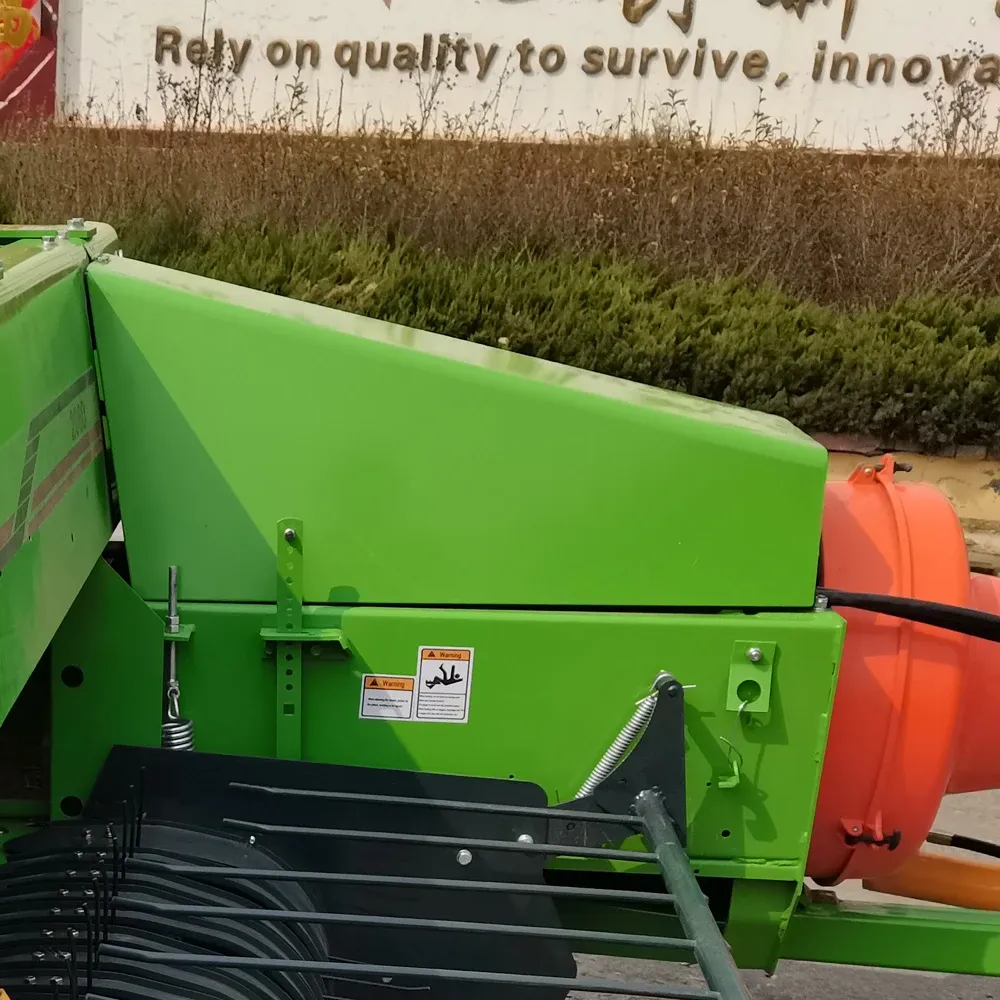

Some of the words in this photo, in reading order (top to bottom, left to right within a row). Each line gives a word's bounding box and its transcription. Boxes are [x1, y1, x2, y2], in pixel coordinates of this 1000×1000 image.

[155, 25, 252, 74] Rely
[267, 36, 321, 69] on
[334, 32, 500, 81] quality
[517, 37, 567, 74] to
[581, 37, 789, 88] survive,
[811, 39, 1000, 85] innova
[440, 651, 461, 659] Warning
[382, 678, 405, 689] Warning
